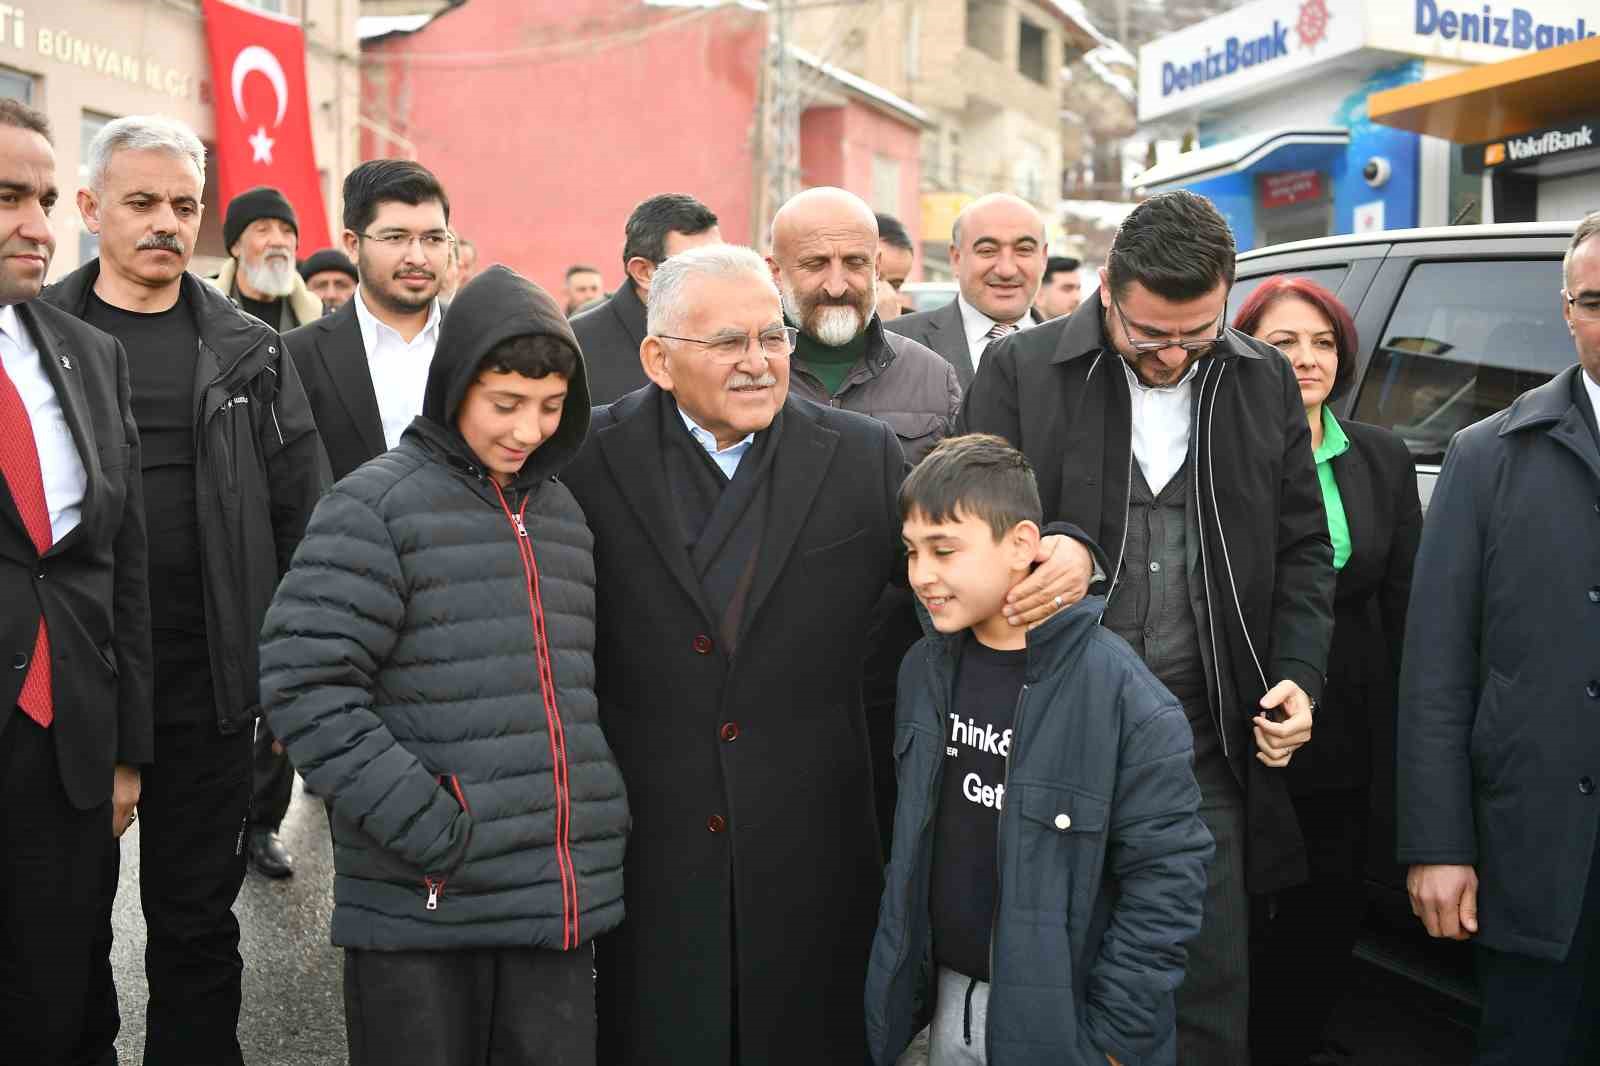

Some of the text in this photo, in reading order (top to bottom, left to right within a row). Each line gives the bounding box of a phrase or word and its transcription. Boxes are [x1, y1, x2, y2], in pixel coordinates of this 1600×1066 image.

[1162, 19, 1289, 96] DenizBank
[1507, 125, 1593, 161] VakıfBank
[963, 772, 1004, 810] Get
